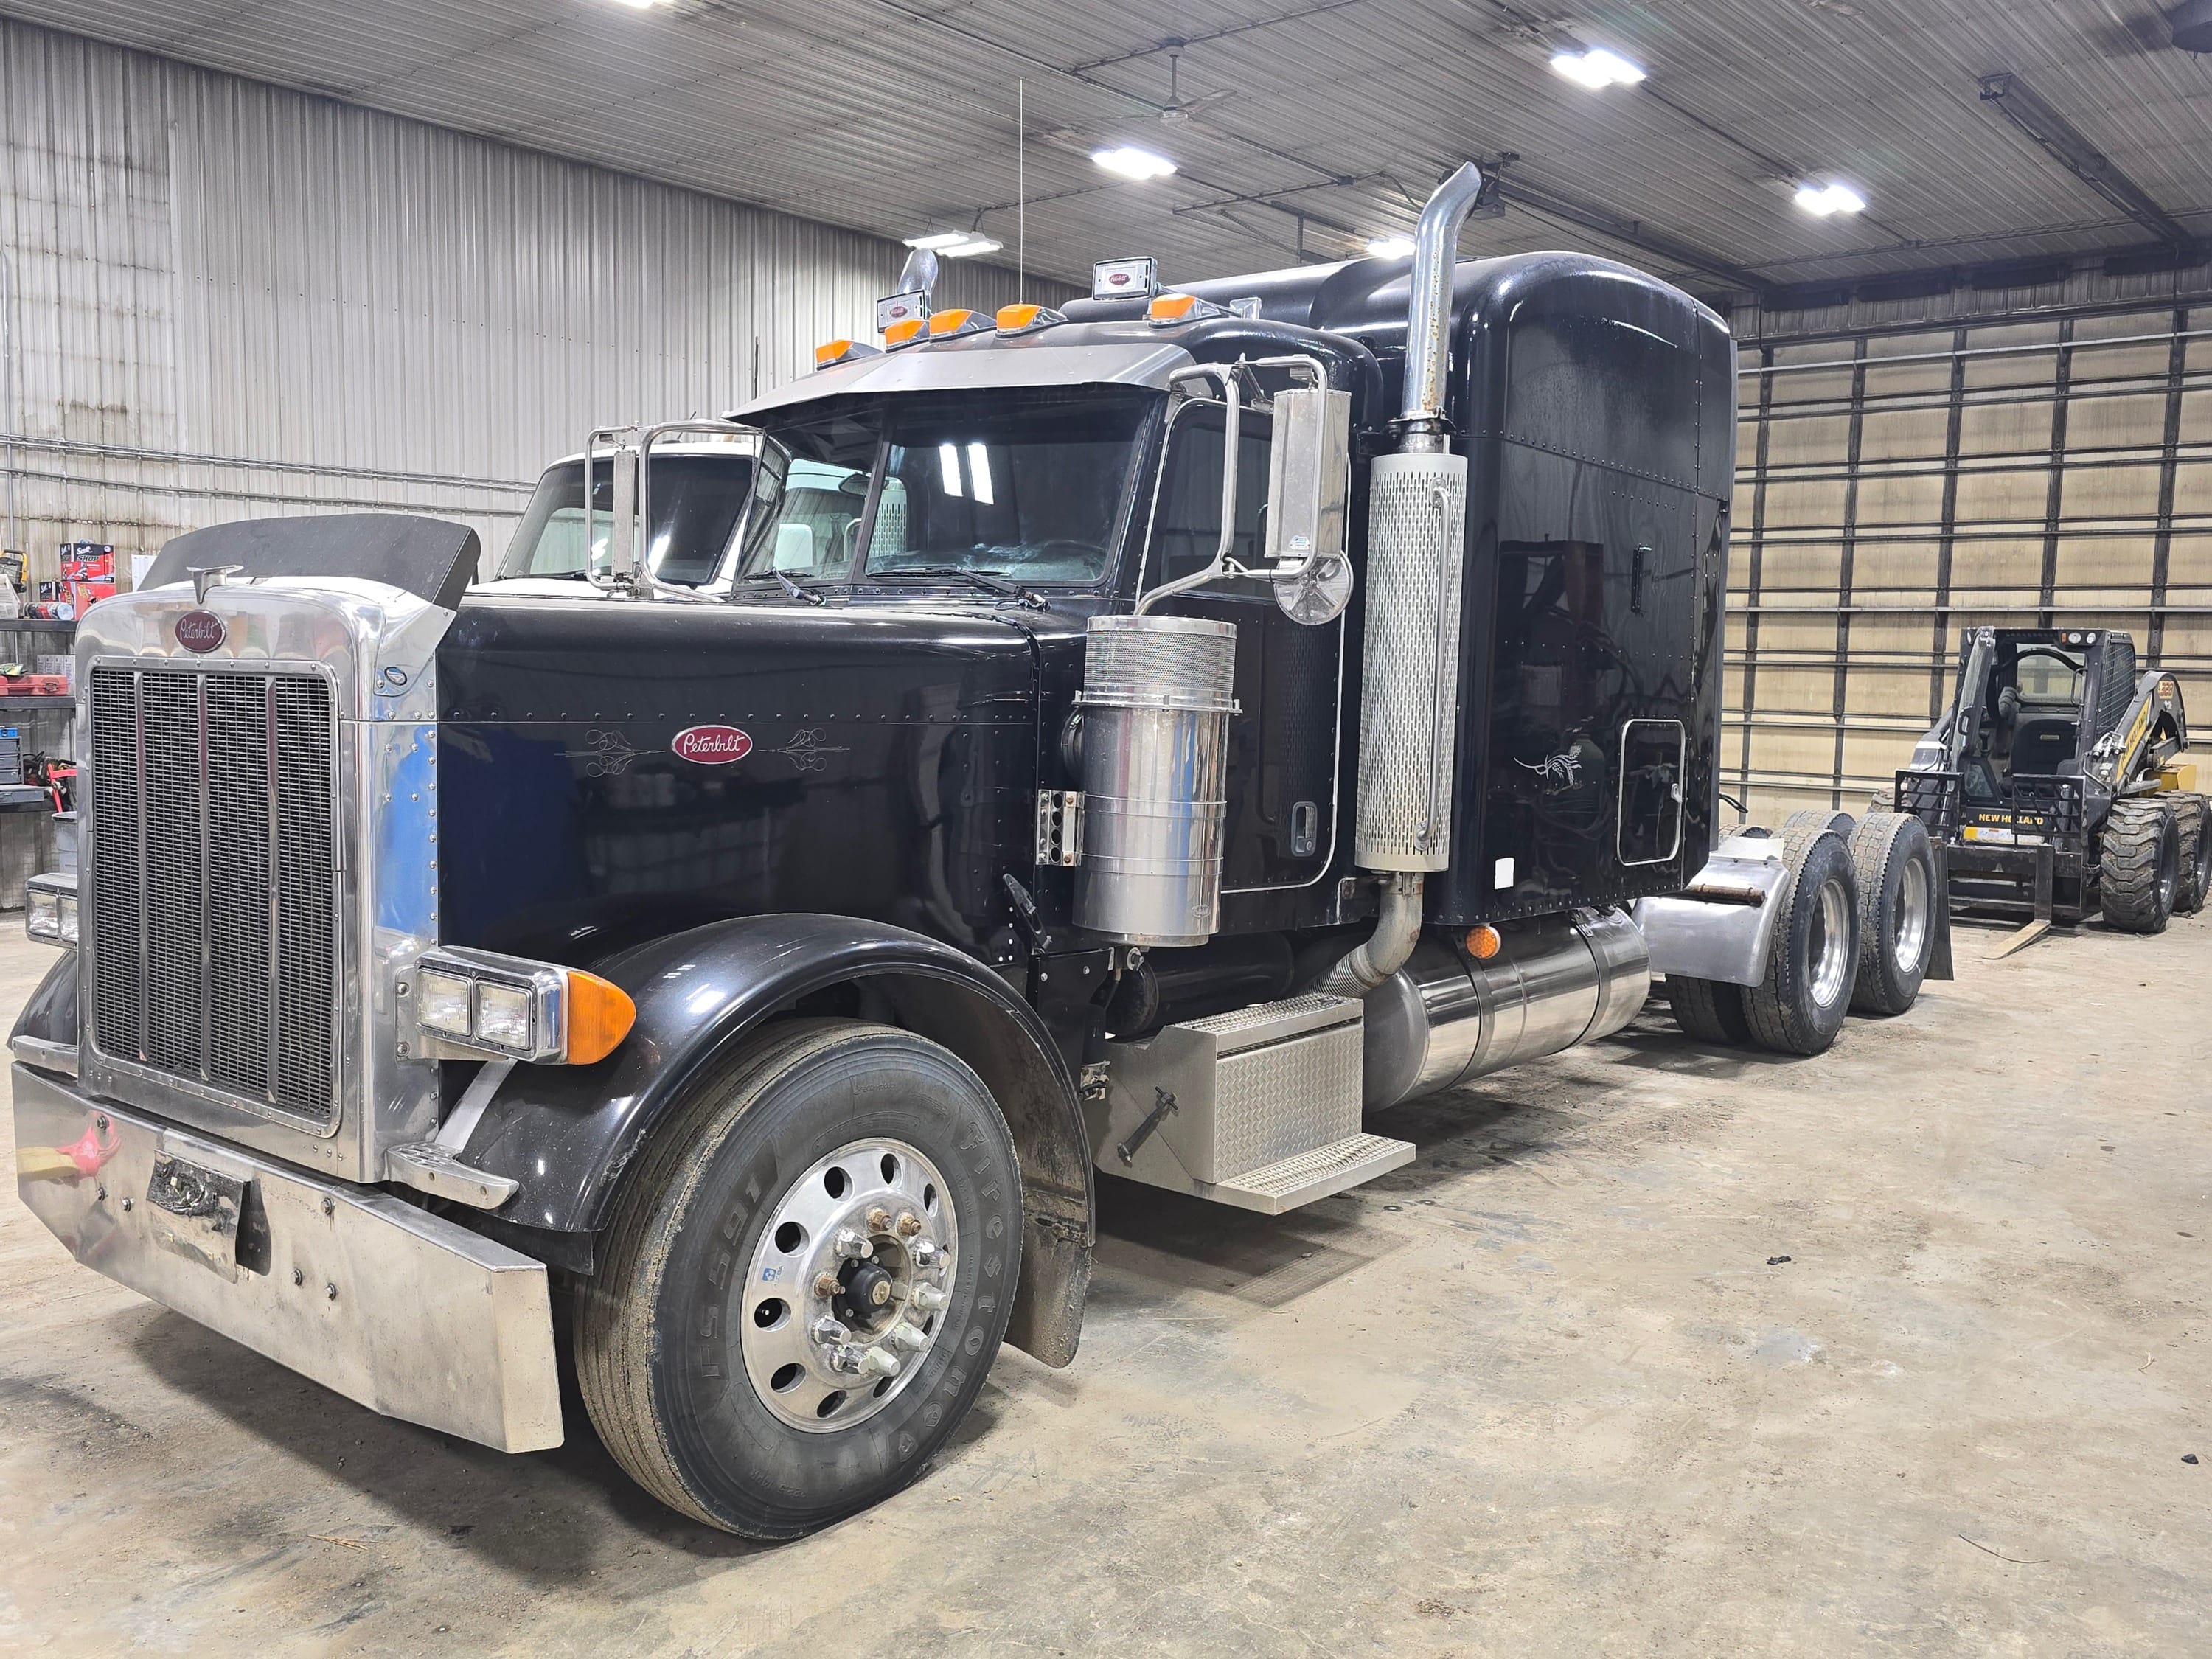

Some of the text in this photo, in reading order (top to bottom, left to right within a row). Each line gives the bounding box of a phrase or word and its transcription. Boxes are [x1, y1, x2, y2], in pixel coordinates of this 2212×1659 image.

[179, 619, 218, 641] Peterbilt
[683, 733, 745, 755] Peterbilt
[1978, 813, 2000, 823] NEW
[923, 1121, 1004, 1429] Firestone
